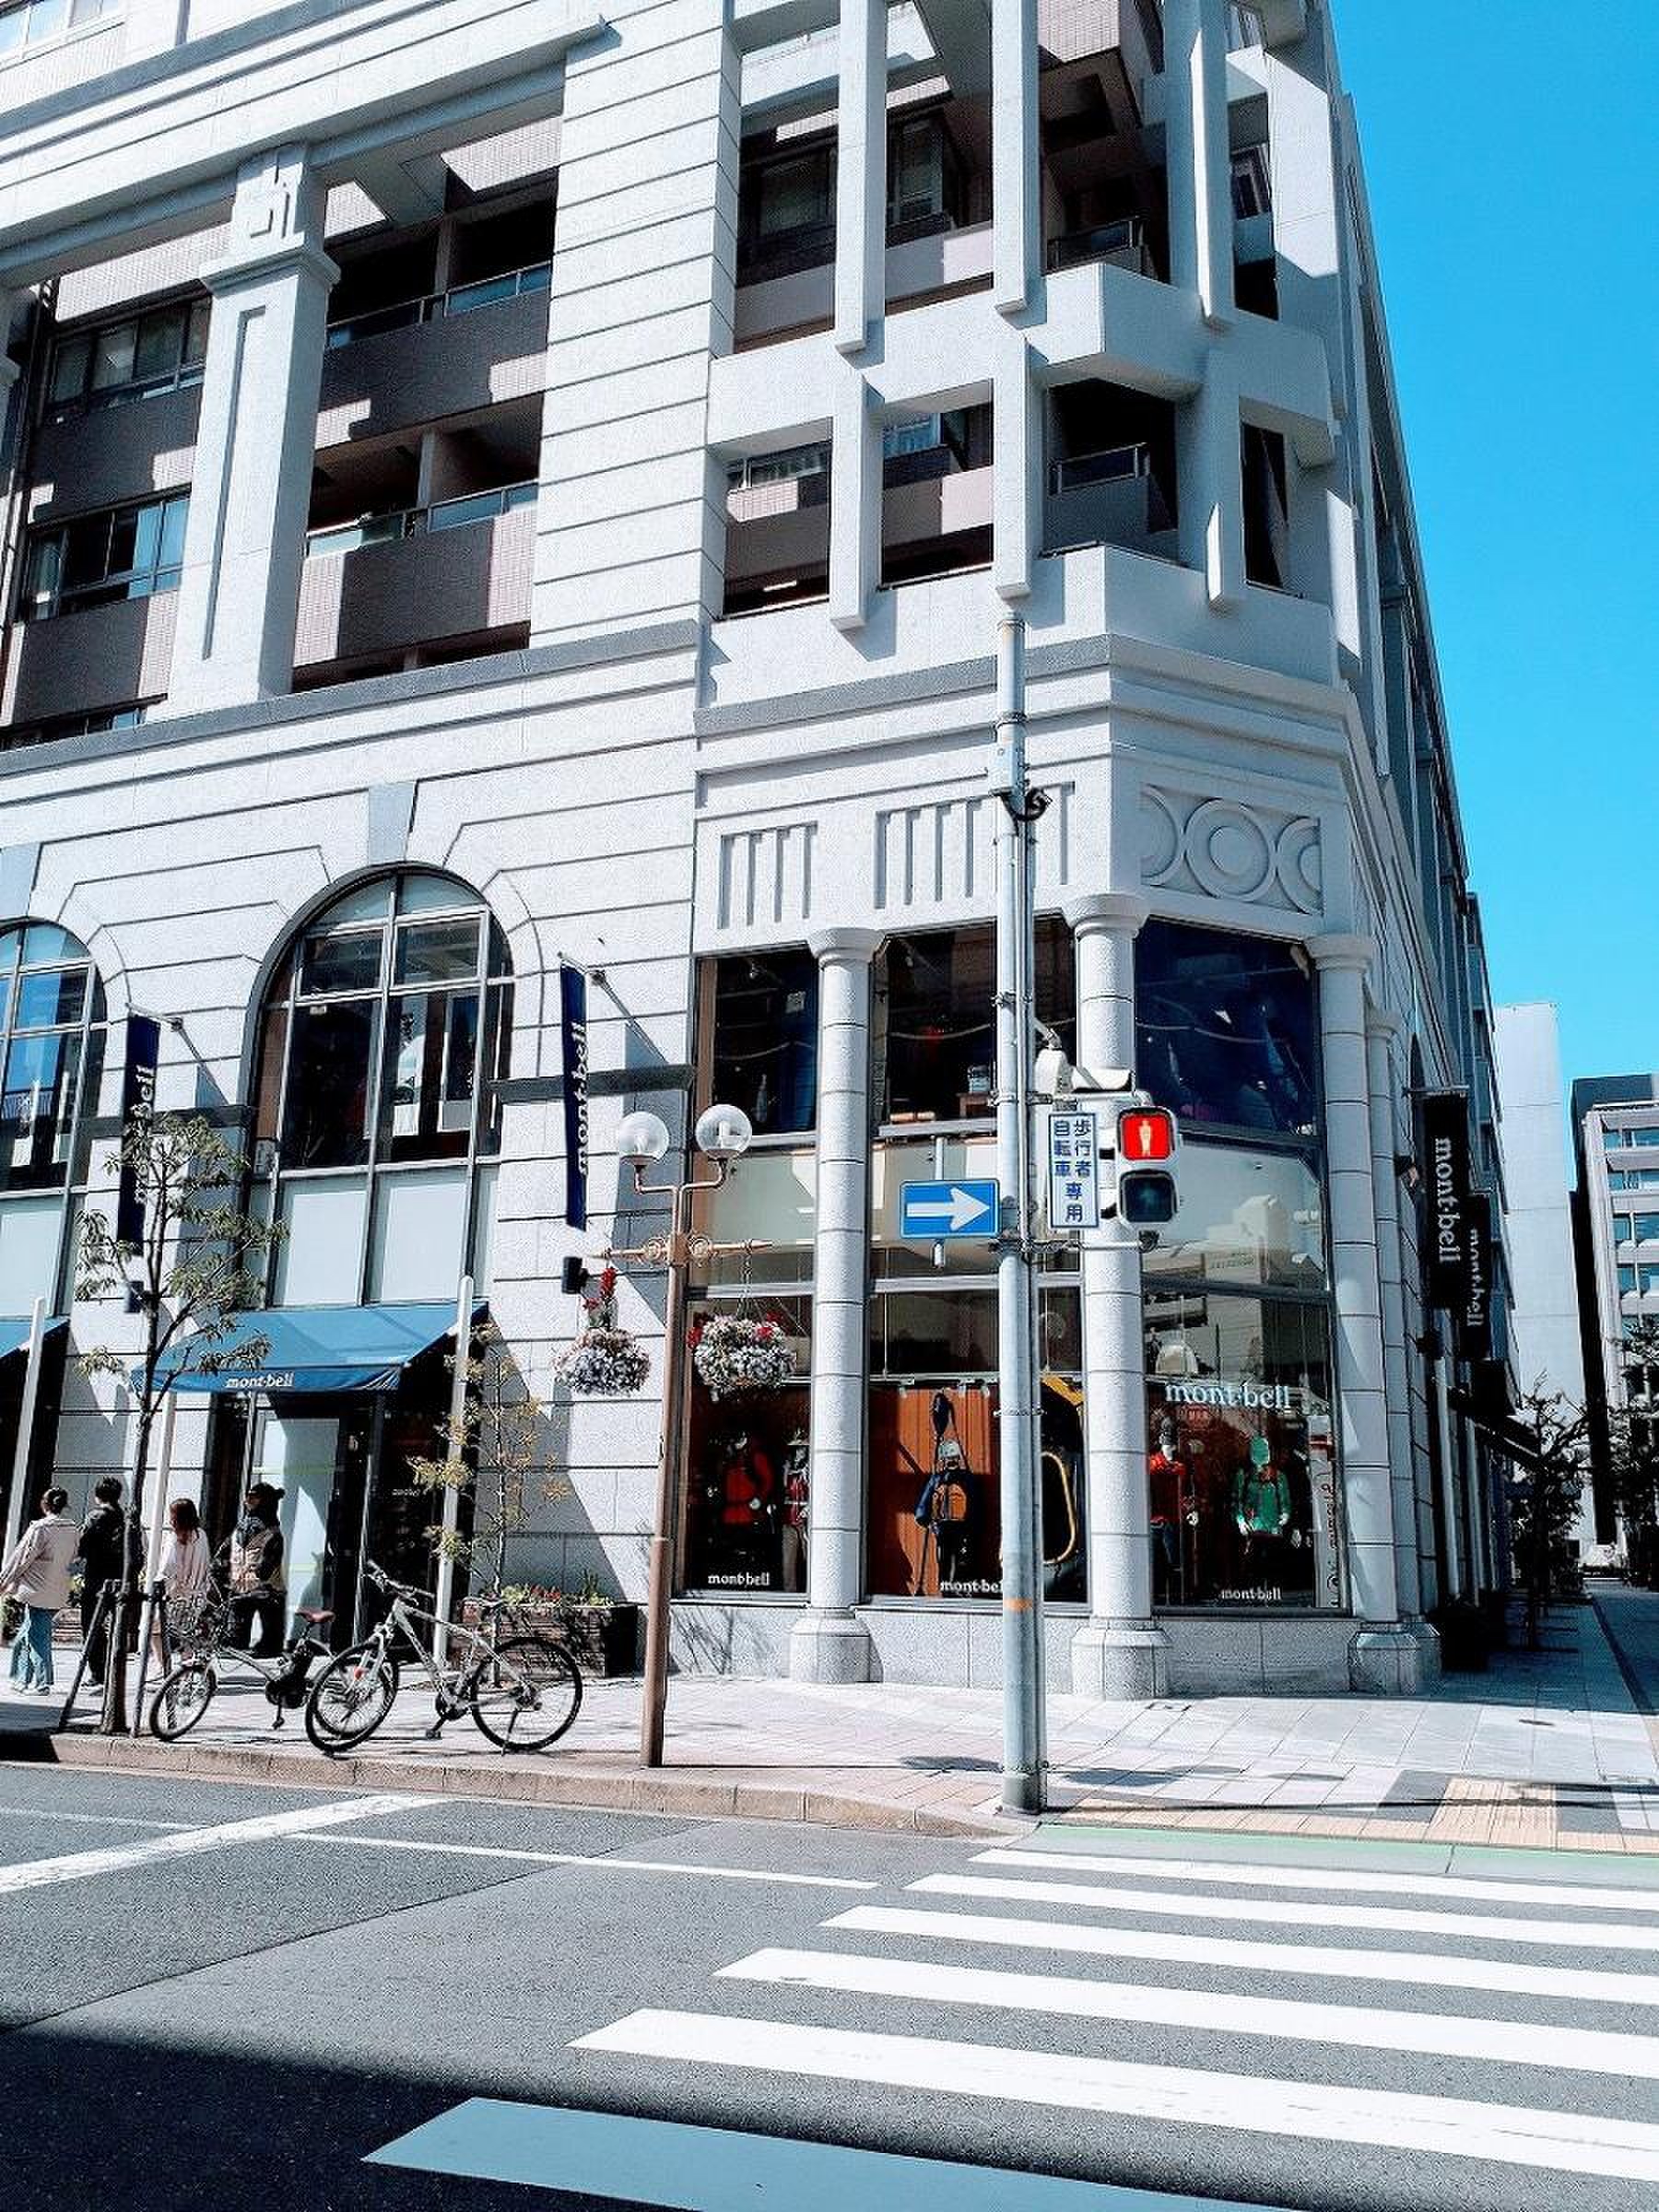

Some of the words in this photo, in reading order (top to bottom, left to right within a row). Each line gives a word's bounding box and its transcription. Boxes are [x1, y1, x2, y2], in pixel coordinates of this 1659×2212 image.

[1053, 1120, 1071, 1177] 自転車
[1074, 1119, 1092, 1177] 歩行者
[1065, 1182, 1083, 1222] 専用
